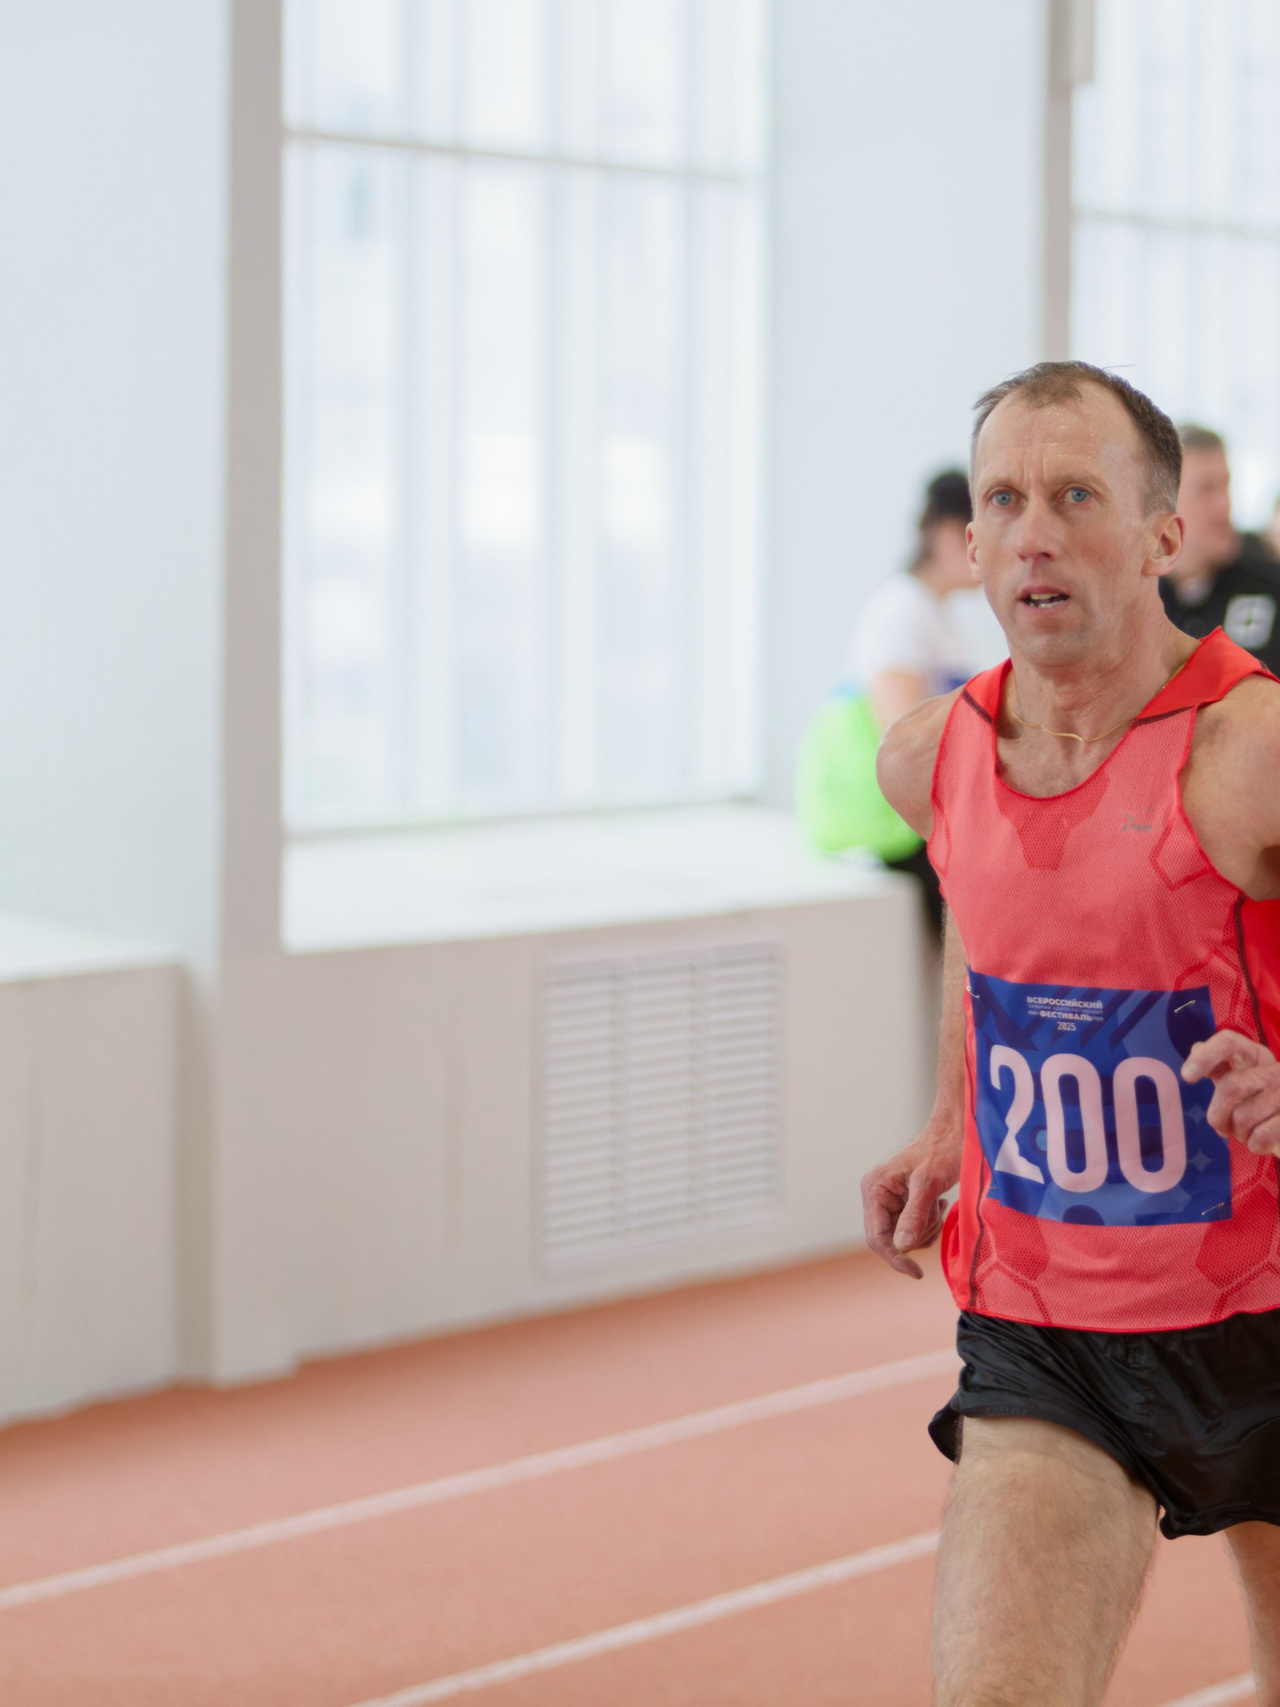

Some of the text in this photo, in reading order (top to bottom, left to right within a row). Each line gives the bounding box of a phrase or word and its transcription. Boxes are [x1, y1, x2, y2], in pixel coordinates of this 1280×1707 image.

[1026, 996, 1103, 1009] ВСЕРОССИЙСКИЙ
[1039, 1010, 1093, 1021] ФЕСТИВАЛЬ
[1057, 1021, 1077, 1031] 2025
[990, 1044, 1187, 1193] 200
